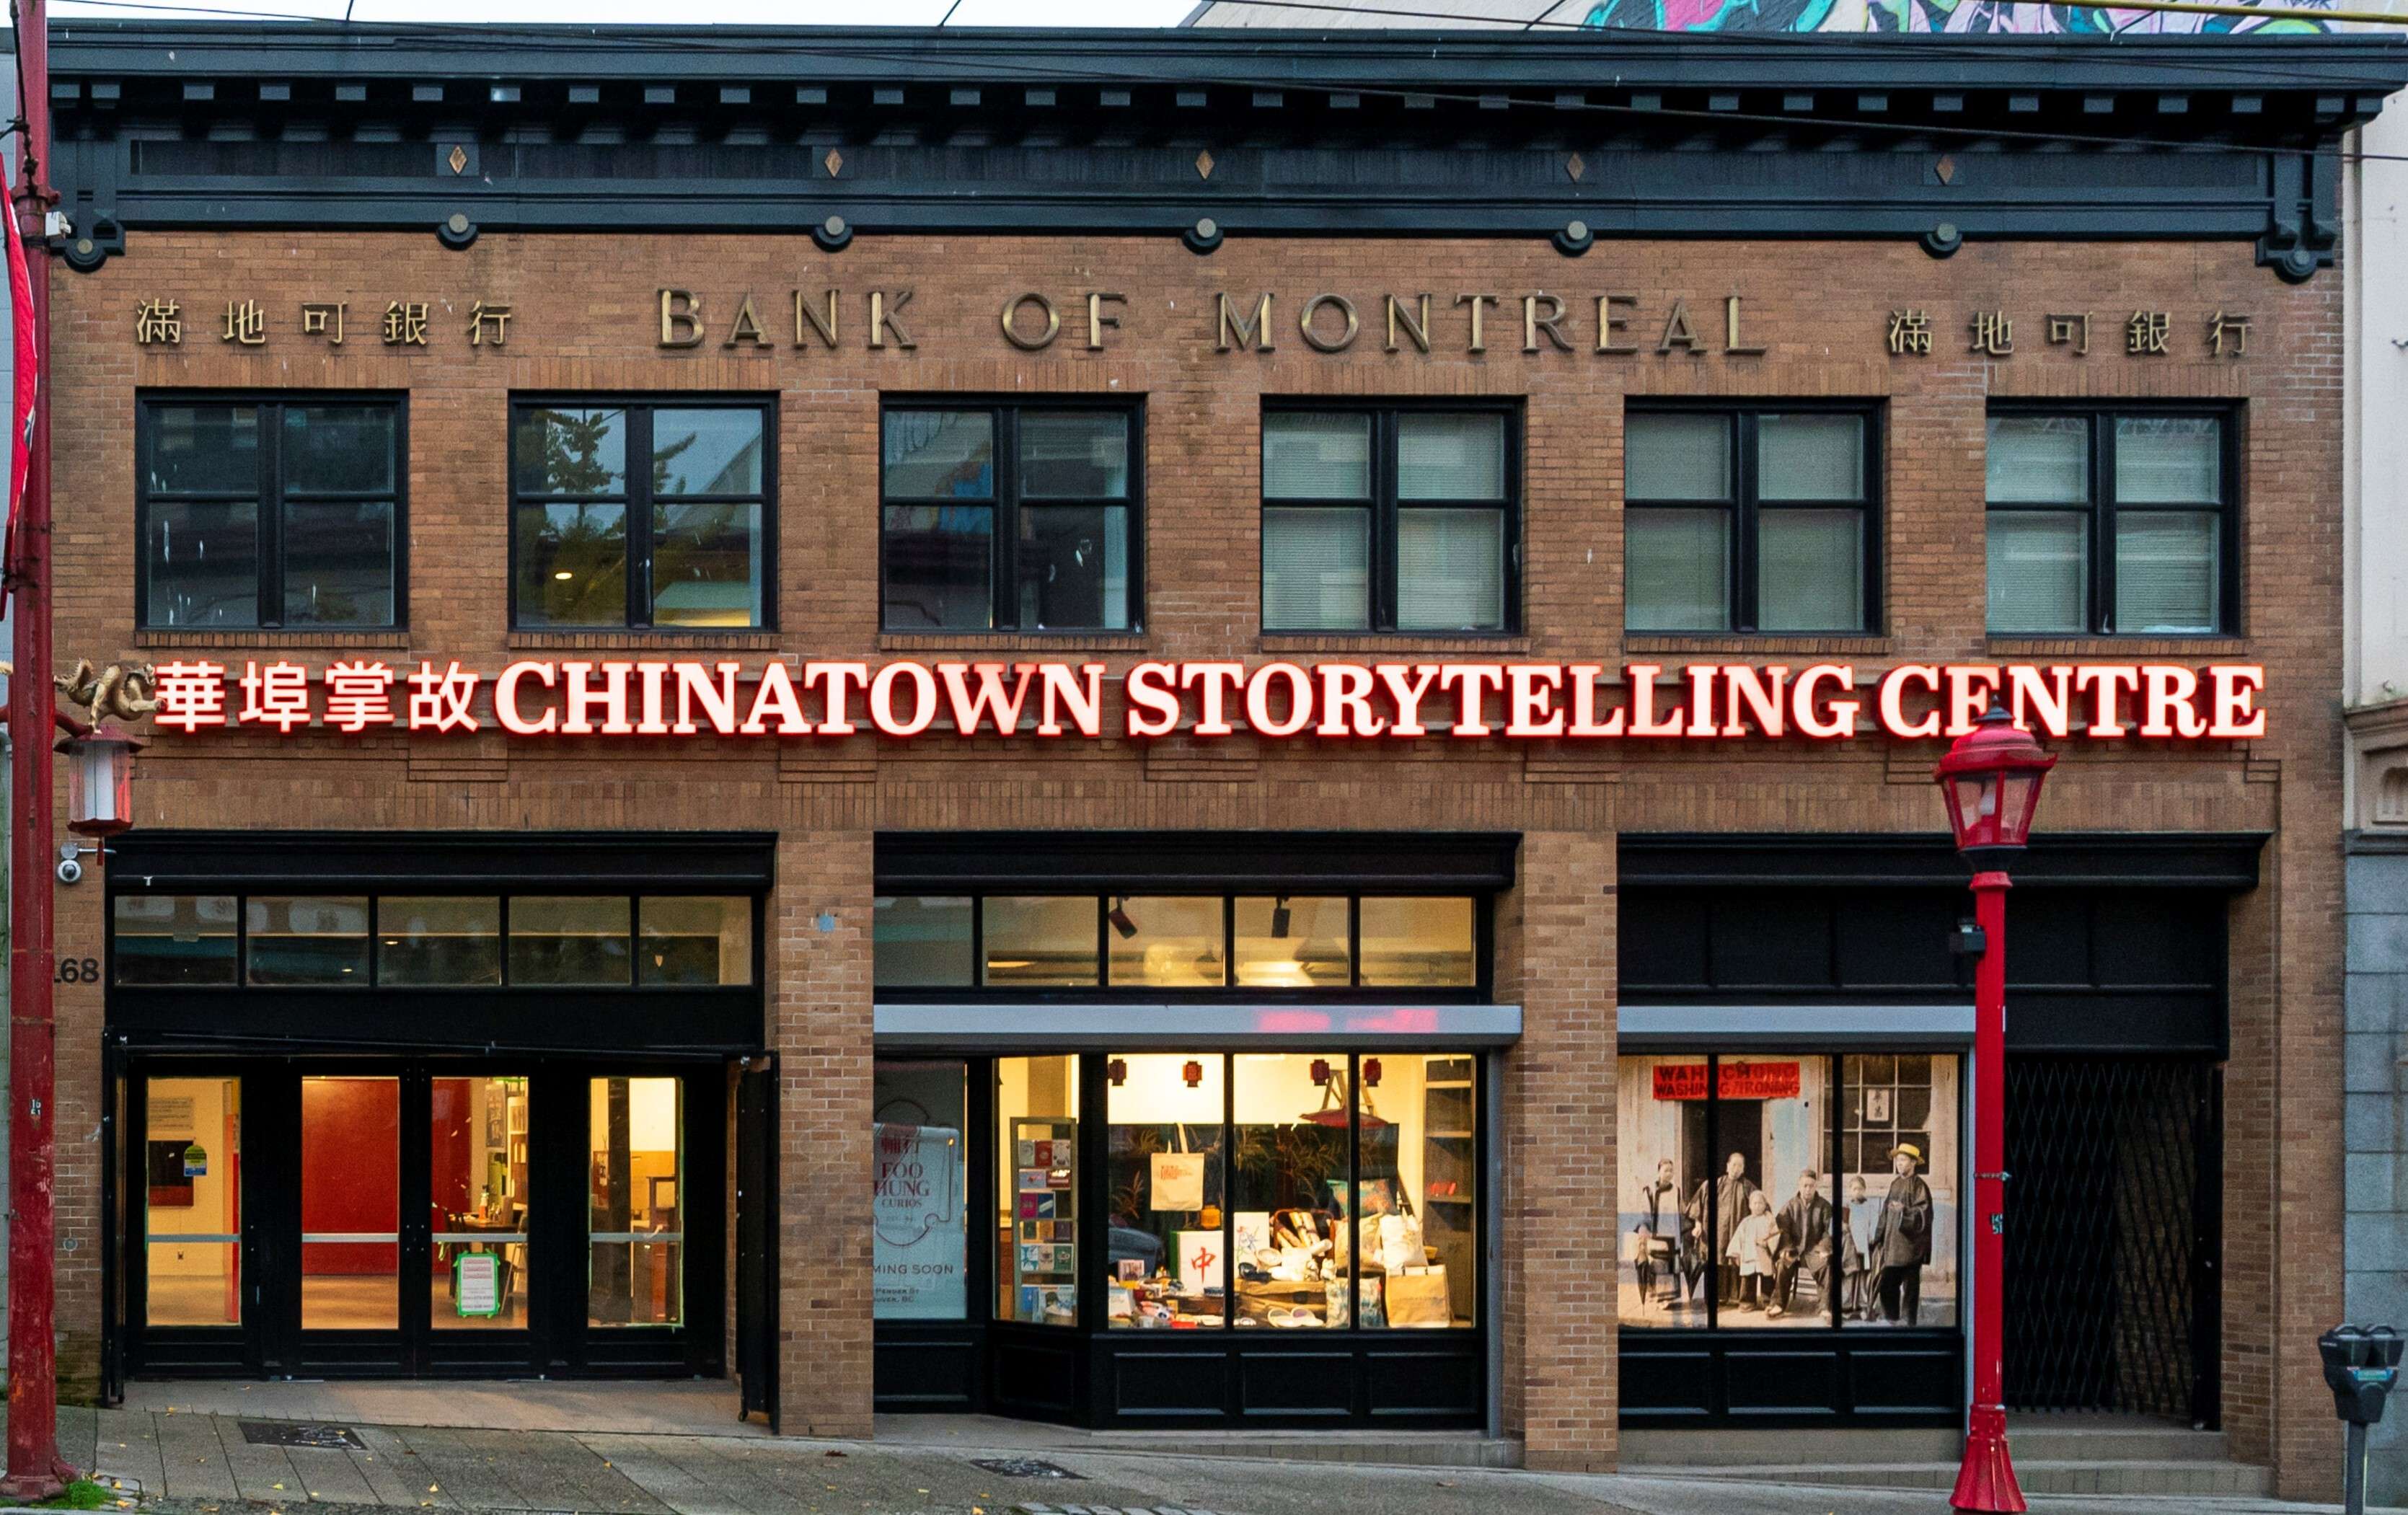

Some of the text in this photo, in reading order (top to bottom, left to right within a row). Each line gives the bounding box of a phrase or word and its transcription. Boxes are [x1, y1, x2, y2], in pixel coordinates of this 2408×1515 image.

[137, 299, 511, 346] 滿地可銀行
[658, 288, 1768, 356] BANK OF MONTREAL
[1888, 309, 2253, 355] 滿地可銀行
[154, 660, 480, 733] 華埠掌故
[494, 661, 2266, 738] CHINATOWN STORYTELLING CENTRE
[54, 958, 100, 983] 68
[882, 1162, 923, 1178] FOO
[912, 1264, 953, 1274] SOON
[1191, 1247, 1216, 1284] 中
